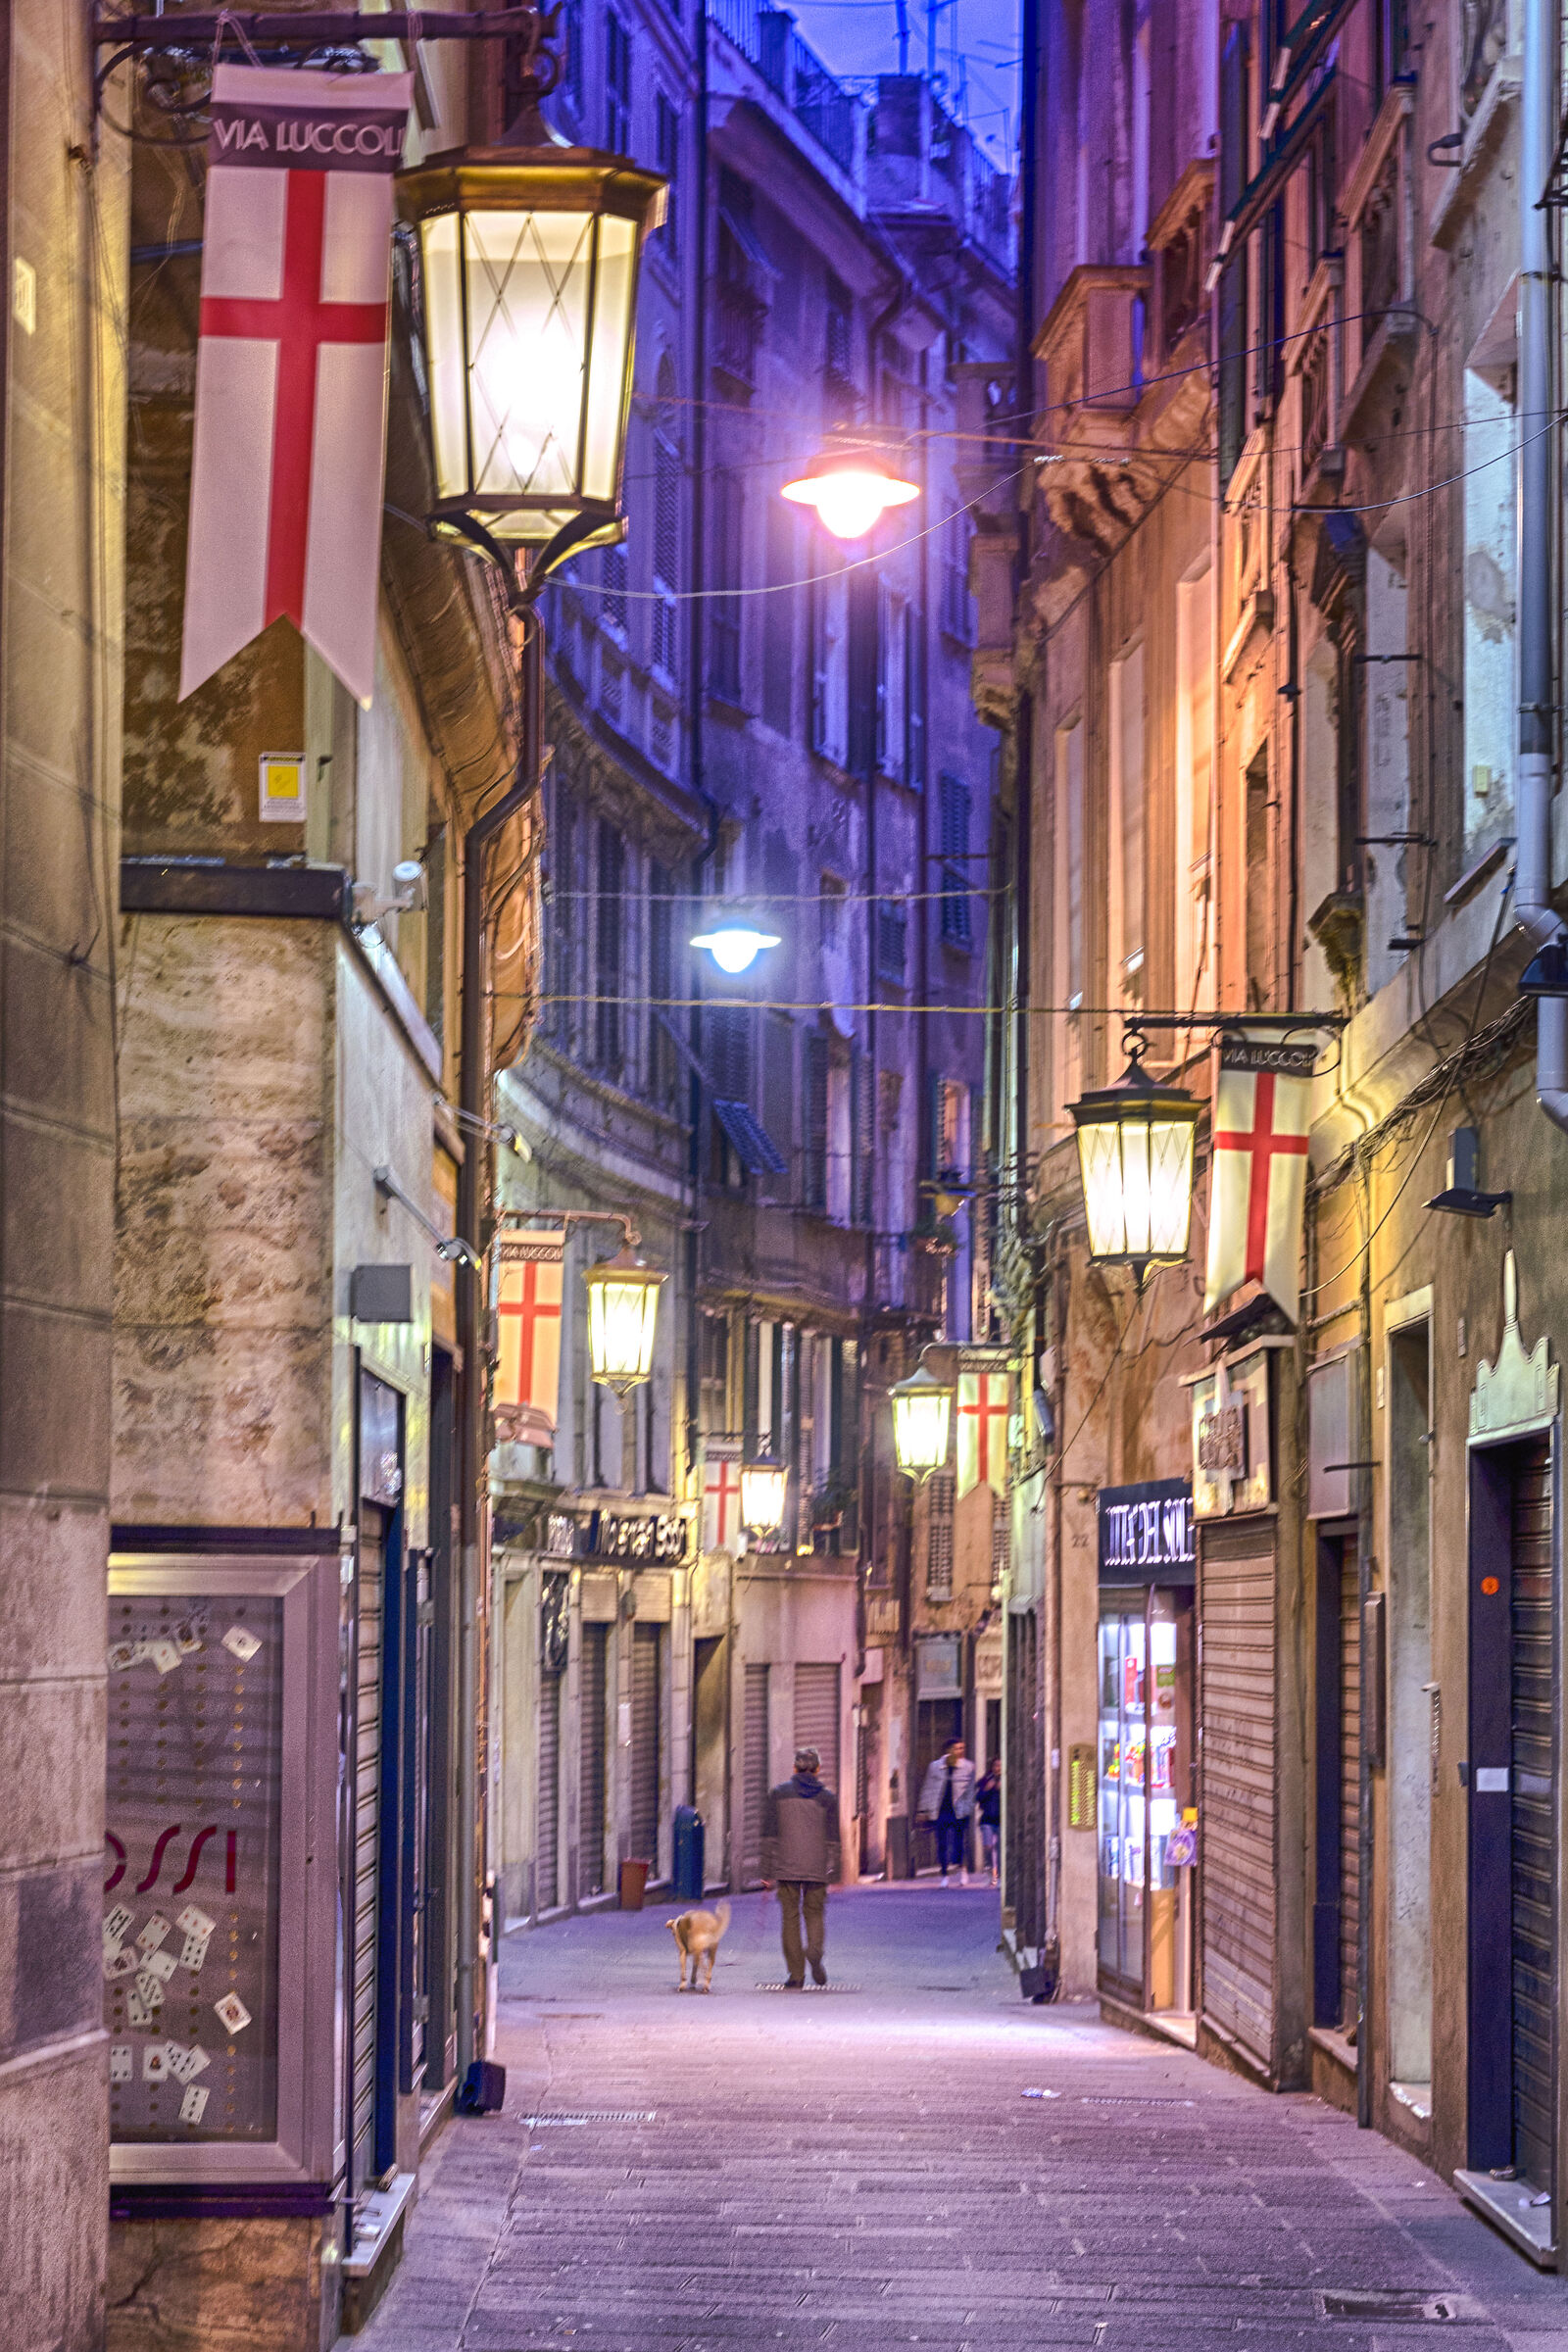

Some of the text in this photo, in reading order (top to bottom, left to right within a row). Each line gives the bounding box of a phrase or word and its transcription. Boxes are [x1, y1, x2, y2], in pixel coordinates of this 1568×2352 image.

[213, 118, 407, 157] VIA LUCCOLI
[1222, 1049, 1249, 1064] VIA
